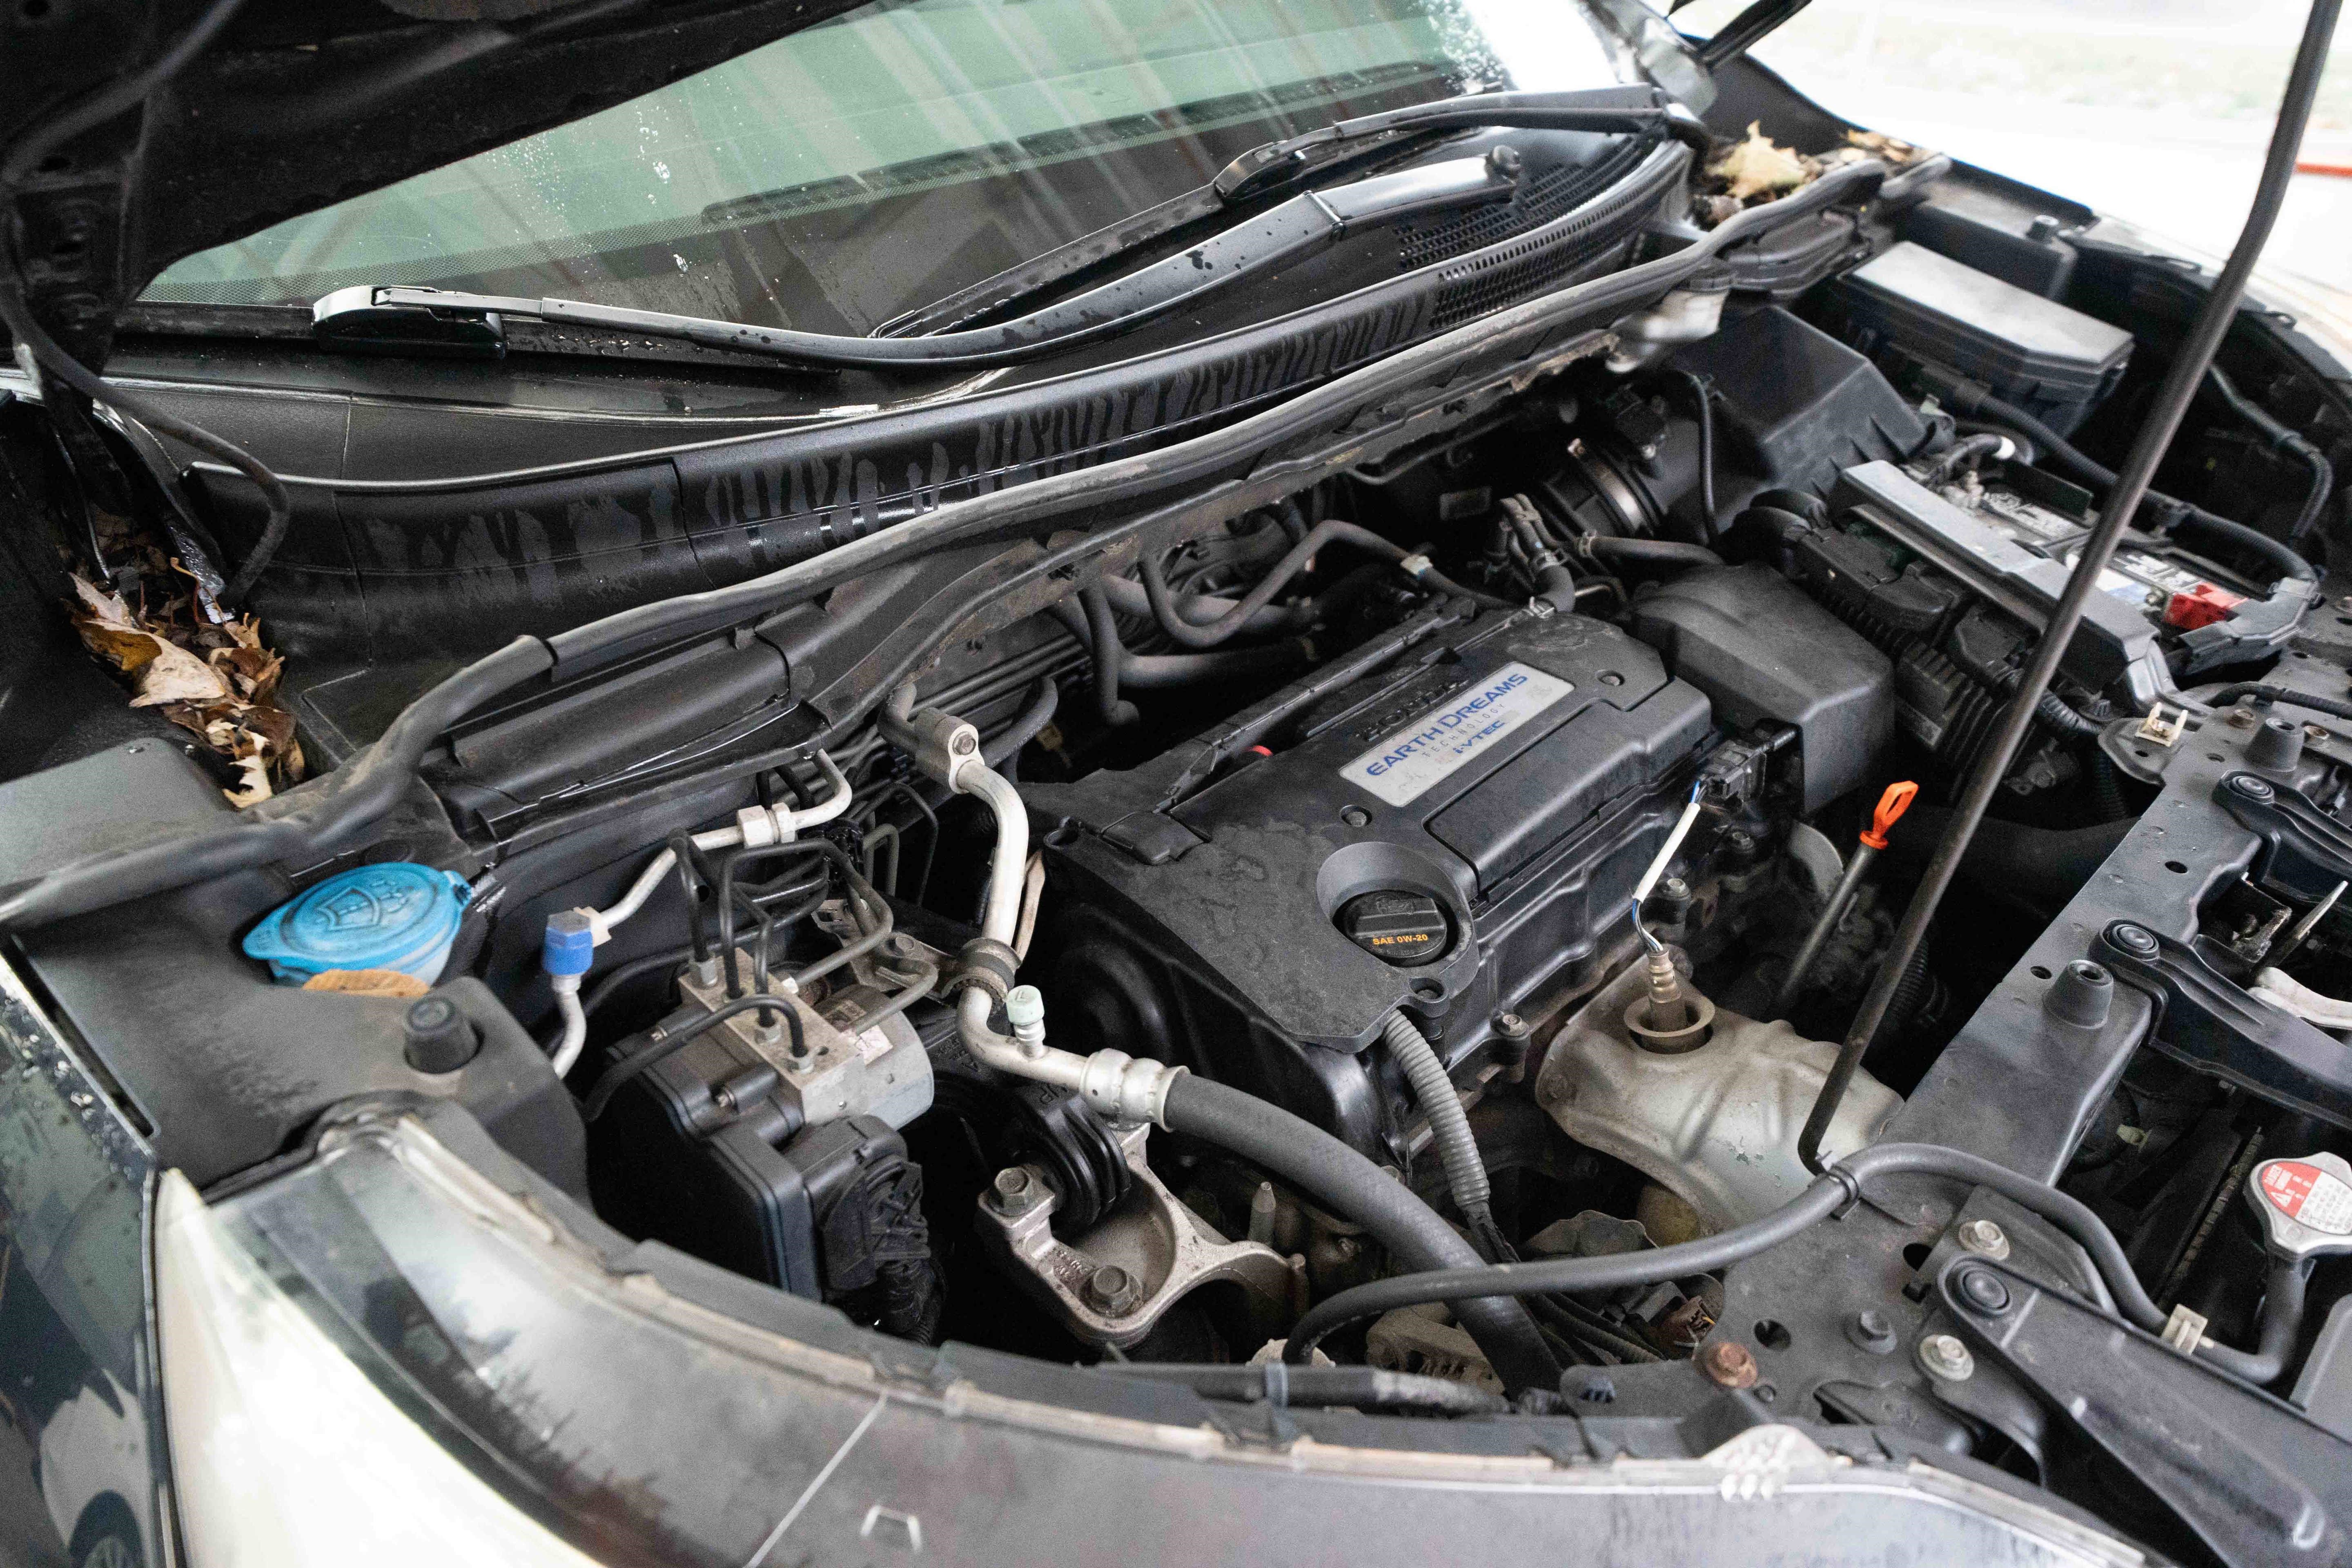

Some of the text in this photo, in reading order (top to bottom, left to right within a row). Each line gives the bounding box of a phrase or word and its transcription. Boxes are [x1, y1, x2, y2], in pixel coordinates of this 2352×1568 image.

[1366, 673, 1528, 776] EARTH DREAMS
[1423, 703, 1505, 757] TECHNOLOGY
[1454, 720, 1506, 754] i-VTEC
[1372, 934, 1428, 945] SAE 0W-20
